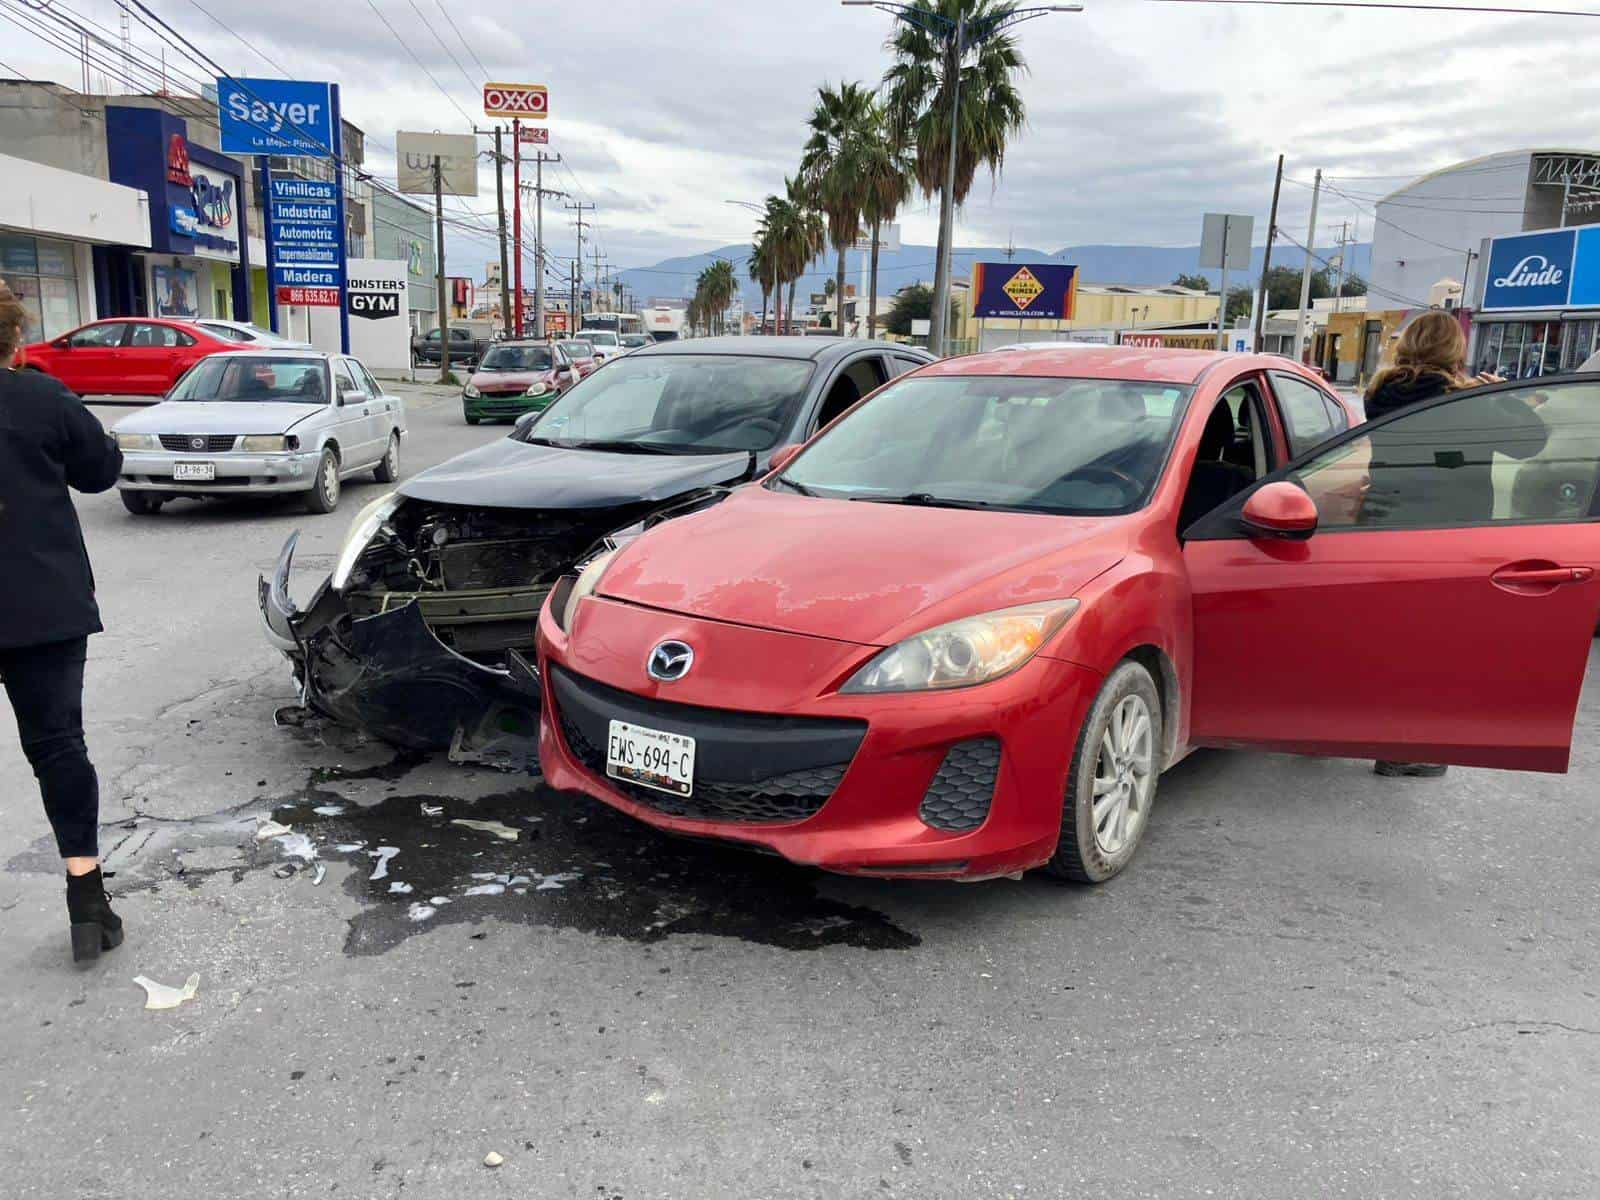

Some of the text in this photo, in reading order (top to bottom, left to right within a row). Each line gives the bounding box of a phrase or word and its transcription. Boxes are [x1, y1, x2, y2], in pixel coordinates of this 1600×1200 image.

[485, 90, 545, 111] OXXO
[228, 92, 320, 133] Sayer
[252, 136, 264, 146] La
[275, 182, 331, 198] Vinilicas
[278, 204, 332, 219] Industrial
[279, 225, 333, 240] Automotriz
[283, 269, 334, 283] Madera
[1494, 255, 1563, 287] Linde
[1007, 287, 1038, 295] PRIMERA
[352, 295, 396, 311] GYM
[1164, 335, 1218, 350] MONCLOV
[609, 735, 689, 778] EWS-694-C
